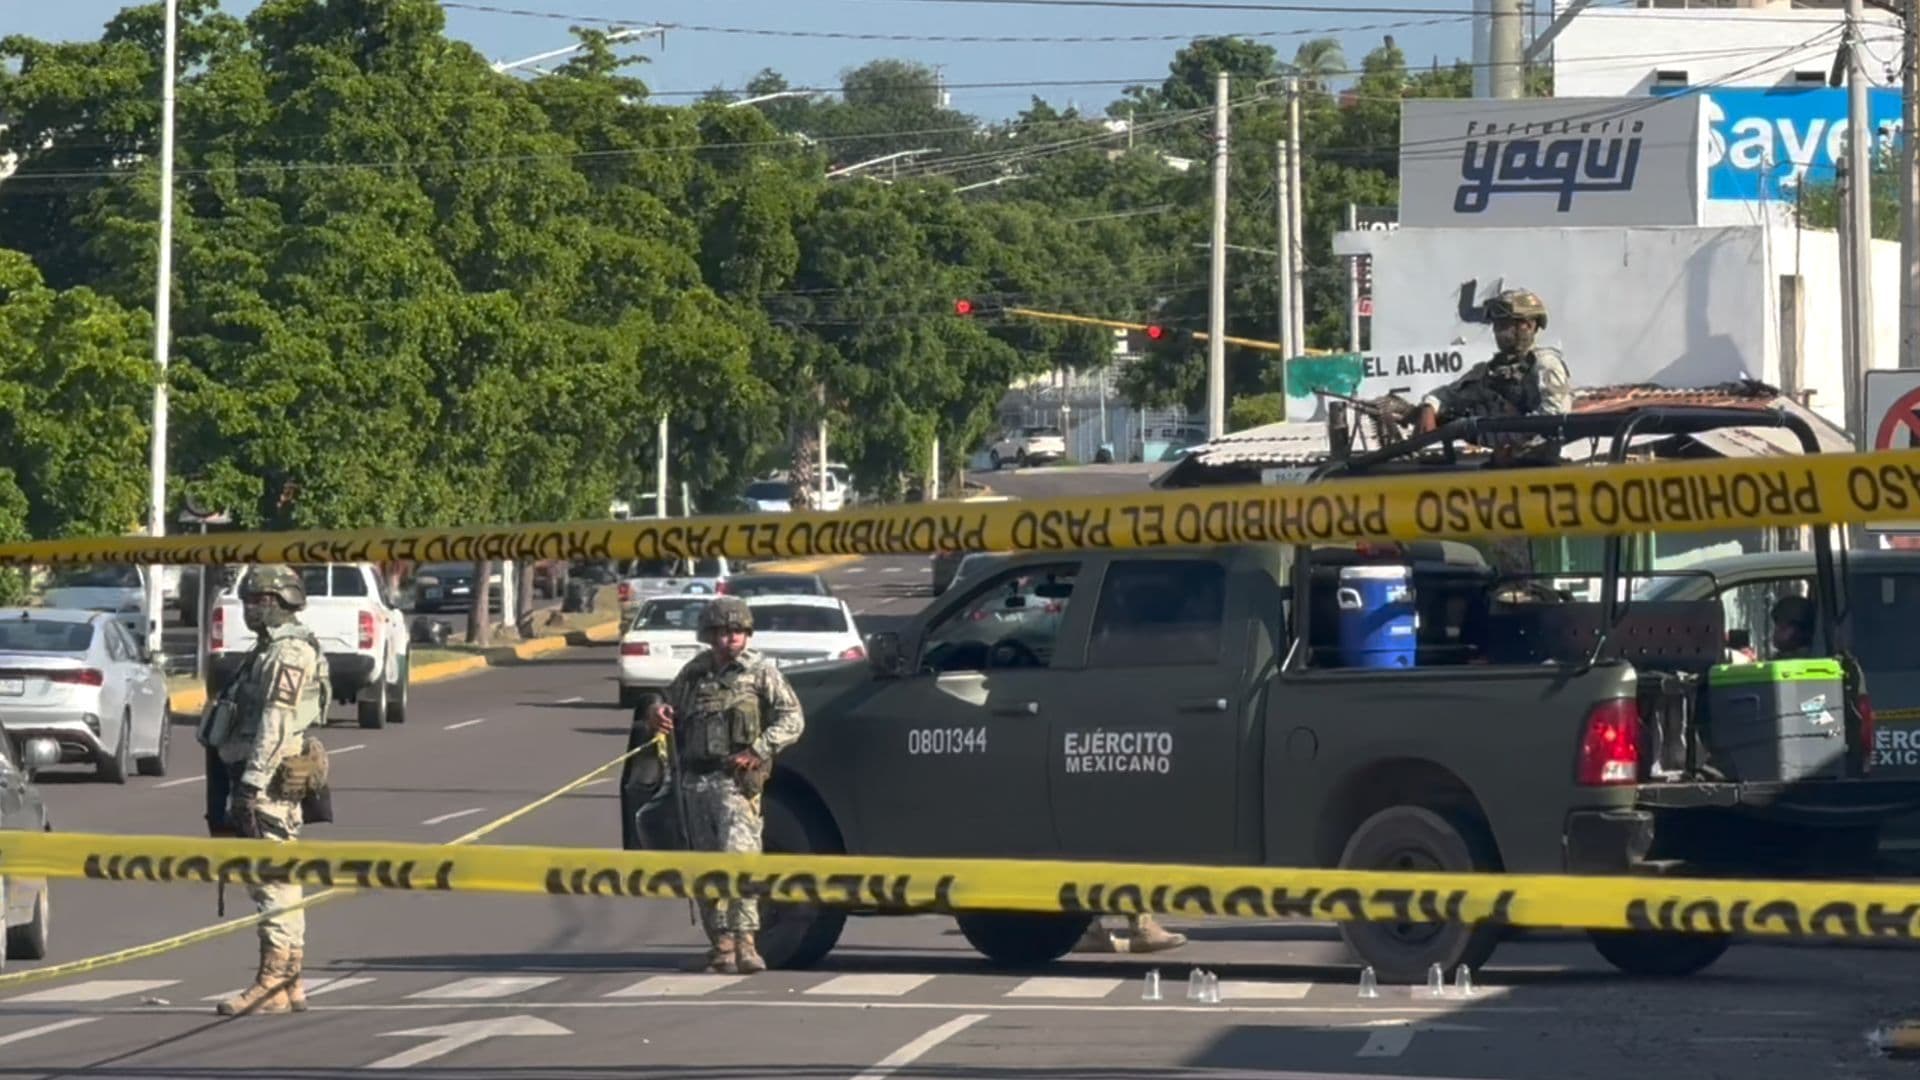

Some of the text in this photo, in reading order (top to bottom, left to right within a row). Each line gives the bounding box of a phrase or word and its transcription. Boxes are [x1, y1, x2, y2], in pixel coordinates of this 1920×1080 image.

[1363, 351, 1463, 378] EL ALAMO
[1415, 469, 1822, 534] PROHIBIDO EL PASO
[633, 513, 988, 559] PROHIBIDO EL PASO
[1010, 493, 1389, 550] PROHIBIDO EL PASO
[281, 529, 612, 562] PROHIBIDO EL PASO
[908, 726, 987, 754] 0801344
[1063, 728, 1173, 755] EJÉRCITO
[1065, 755, 1170, 773] MEXICANO
